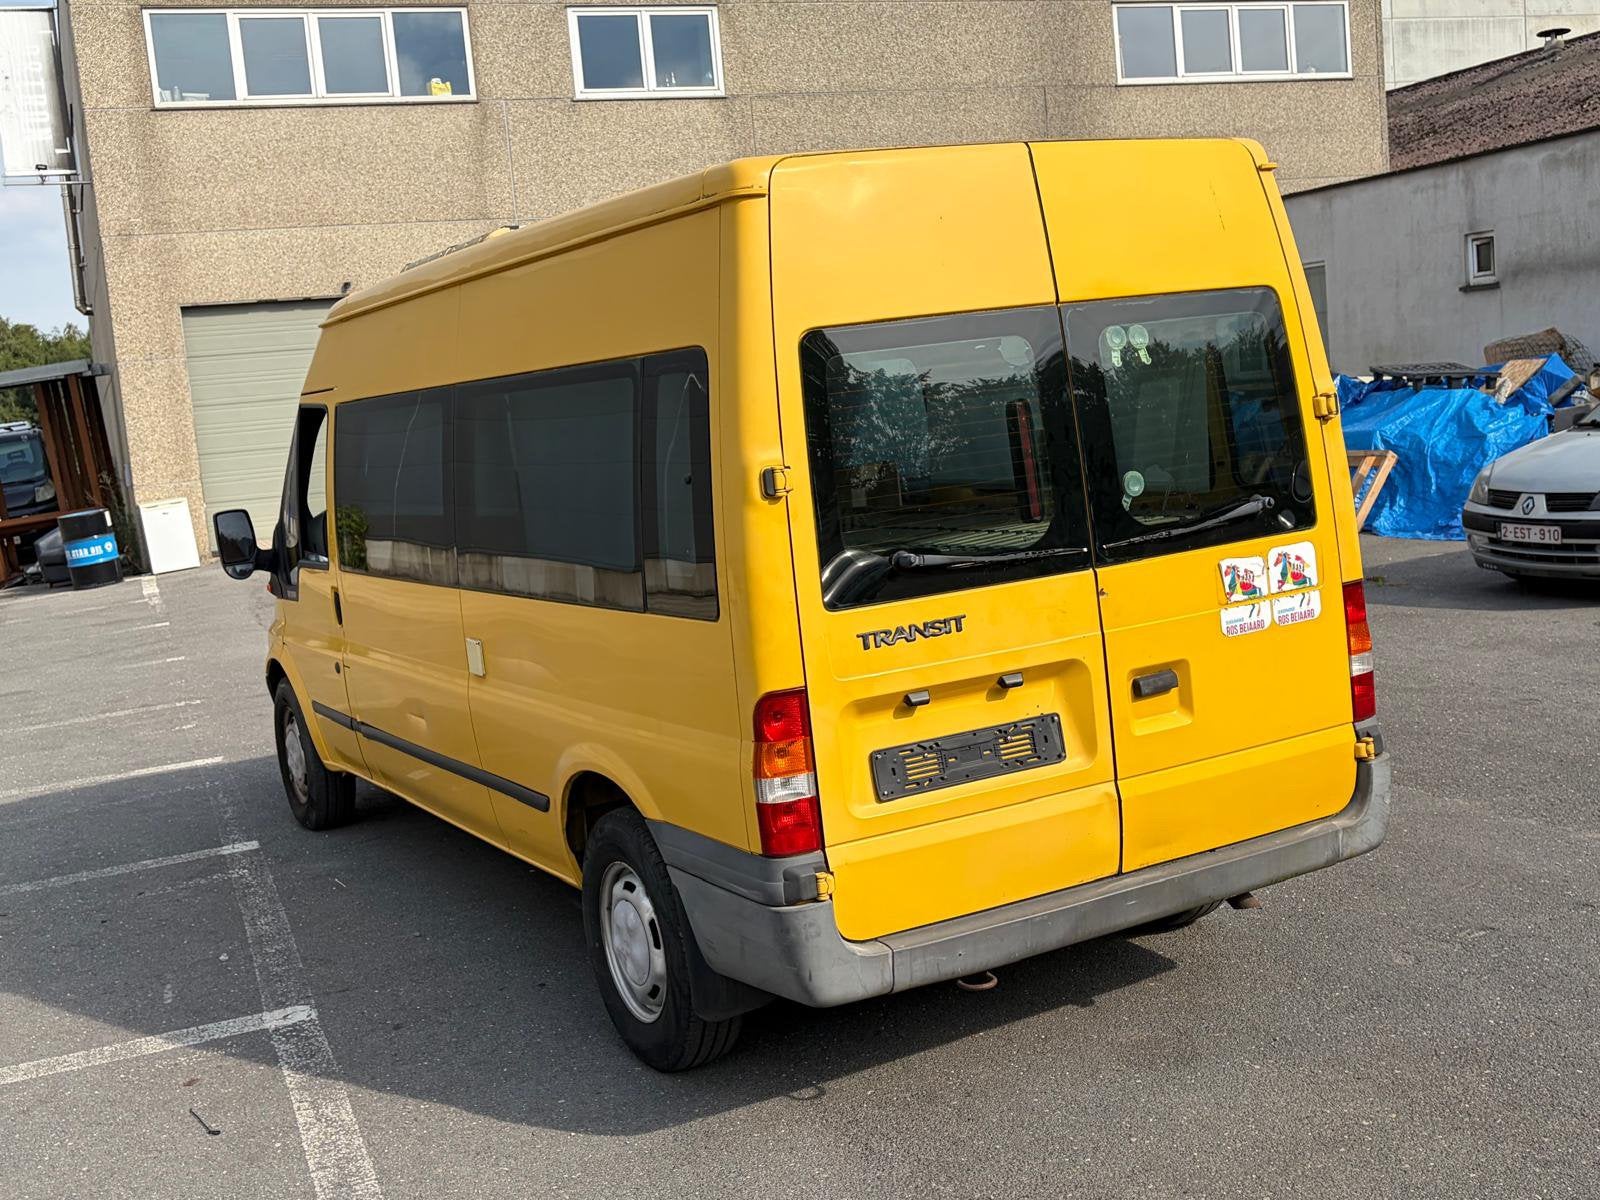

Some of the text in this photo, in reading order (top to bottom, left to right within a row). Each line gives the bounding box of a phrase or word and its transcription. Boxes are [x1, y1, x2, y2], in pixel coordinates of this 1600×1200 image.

[1278, 613, 1290, 624] ROS
[856, 614, 966, 650] TRANSIT
[1226, 624, 1239, 635] ROS
